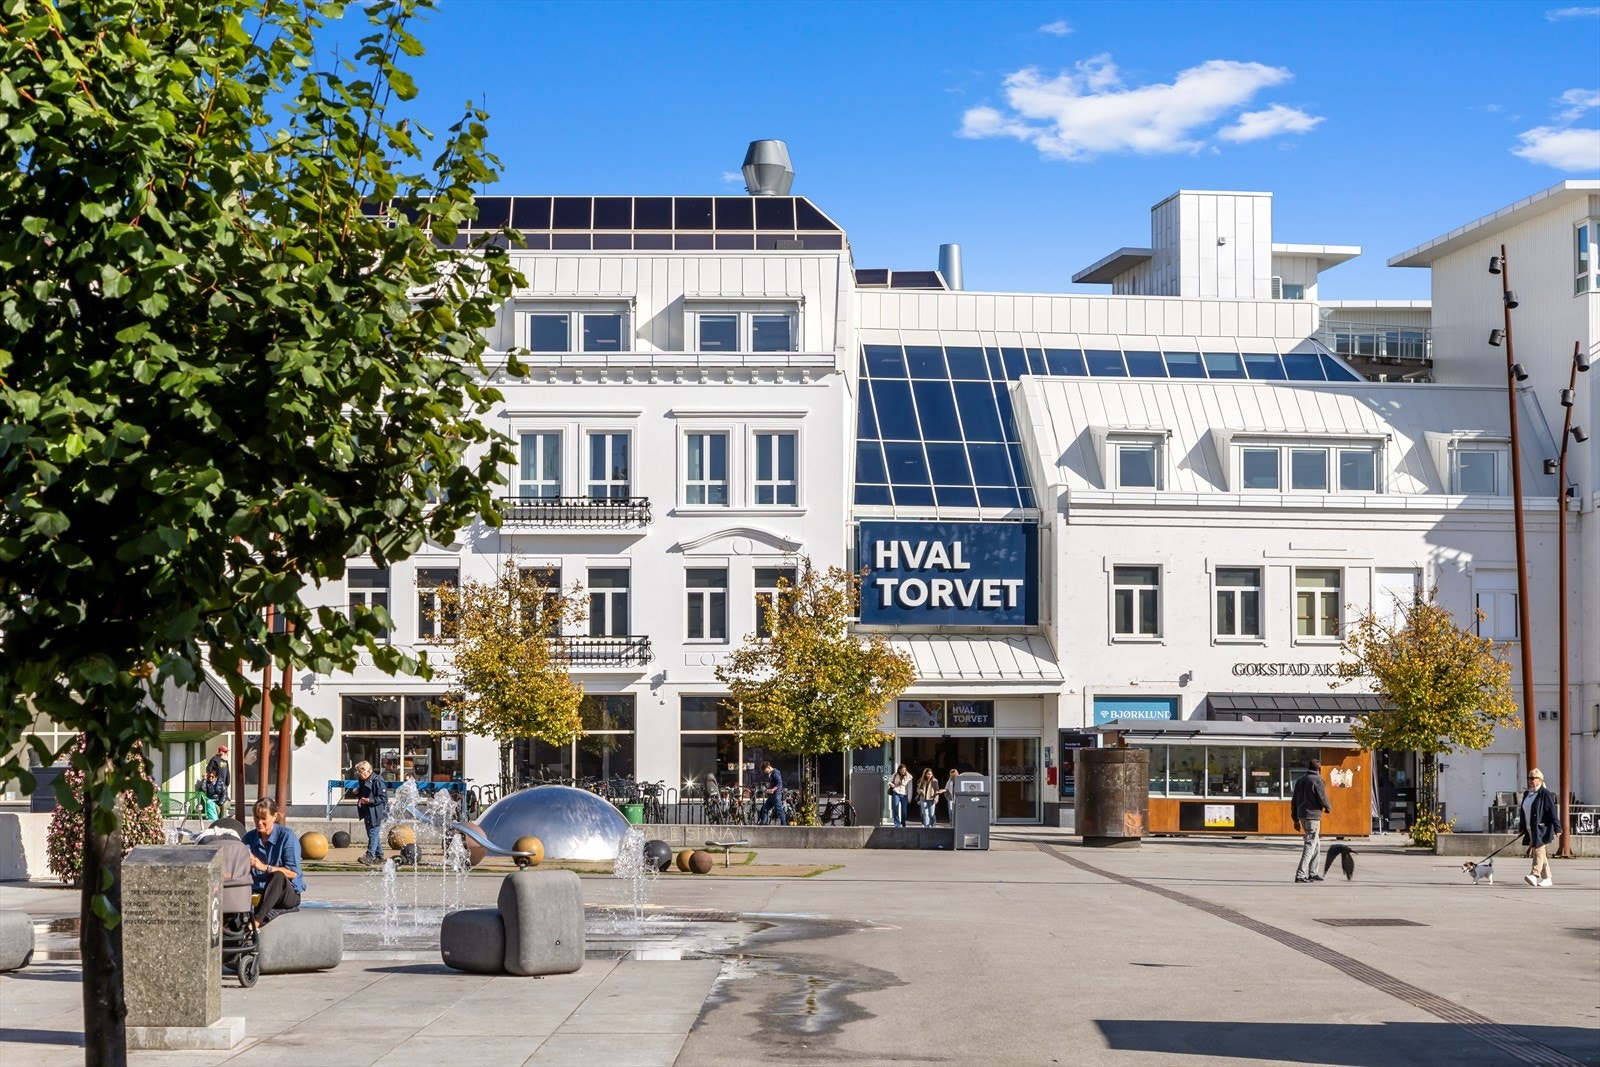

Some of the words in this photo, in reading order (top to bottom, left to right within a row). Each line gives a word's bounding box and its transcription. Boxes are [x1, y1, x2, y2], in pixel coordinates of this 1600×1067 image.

[875, 540, 971, 569] HVAL
[876, 578, 1024, 608] TORVET
[1233, 663, 1310, 676] GOKSTAD
[952, 706, 976, 714] HVAL
[1110, 710, 1172, 719] BJØRKLUND
[953, 715, 989, 723] TORVET
[635, 826, 736, 842] ALESTINA
